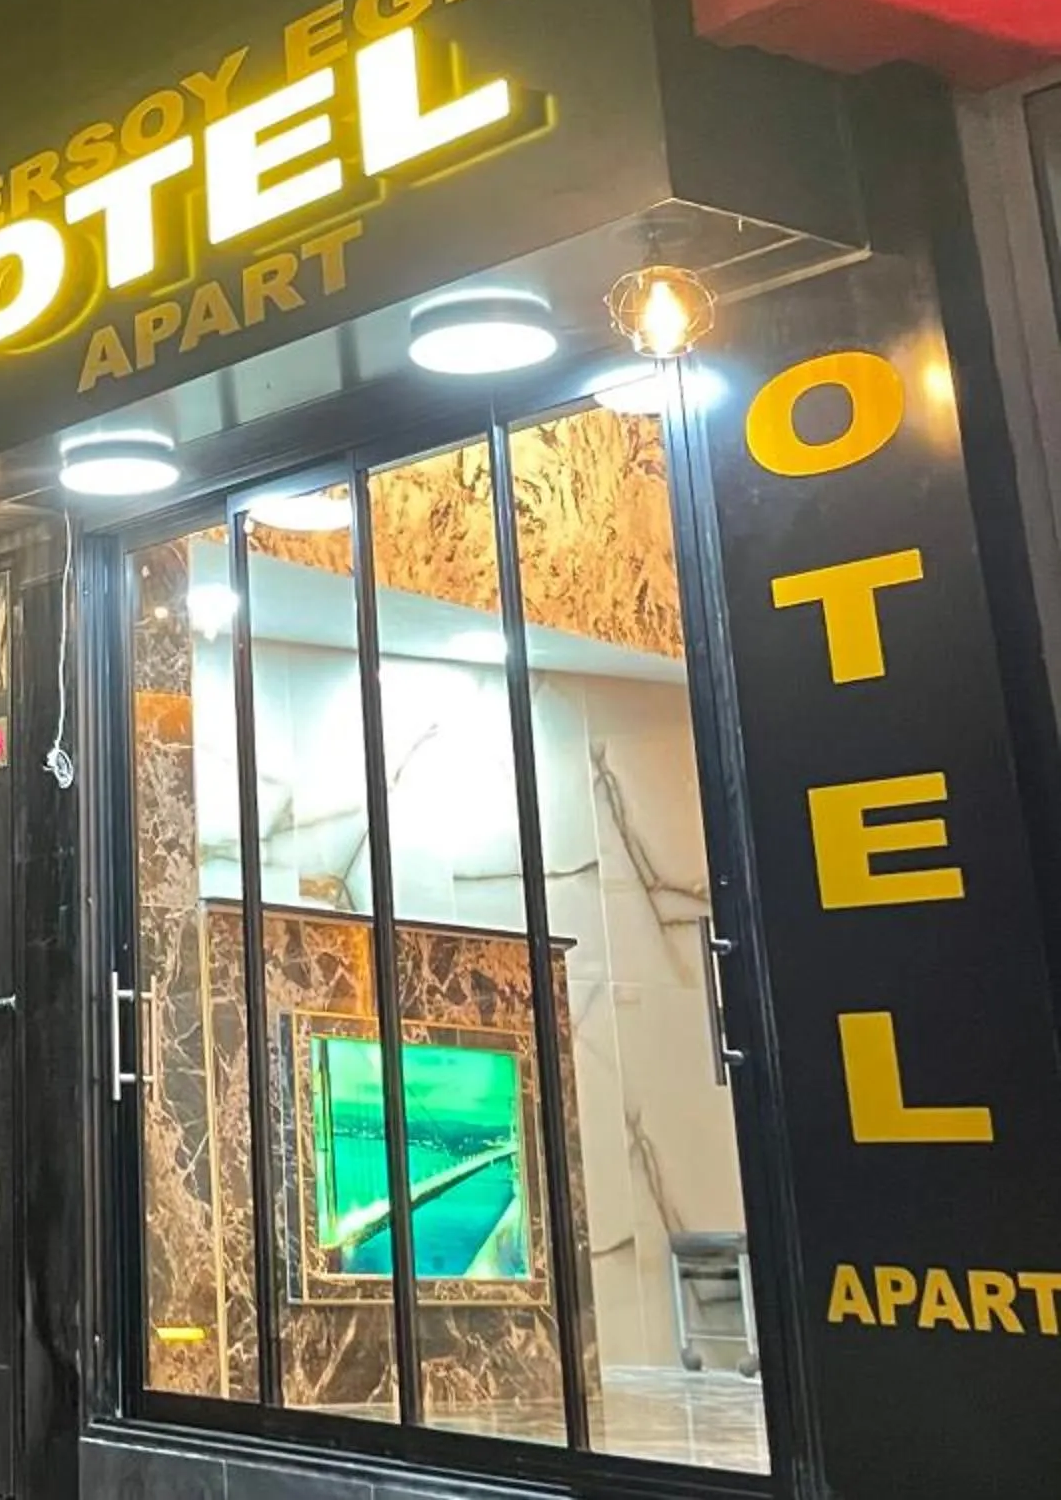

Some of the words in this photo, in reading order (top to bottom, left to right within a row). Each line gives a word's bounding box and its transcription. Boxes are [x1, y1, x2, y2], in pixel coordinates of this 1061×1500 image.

[77, 219, 364, 393] APART
[745, 351, 993, 1143] OTEL
[828, 1263, 1061, 1335] APART
